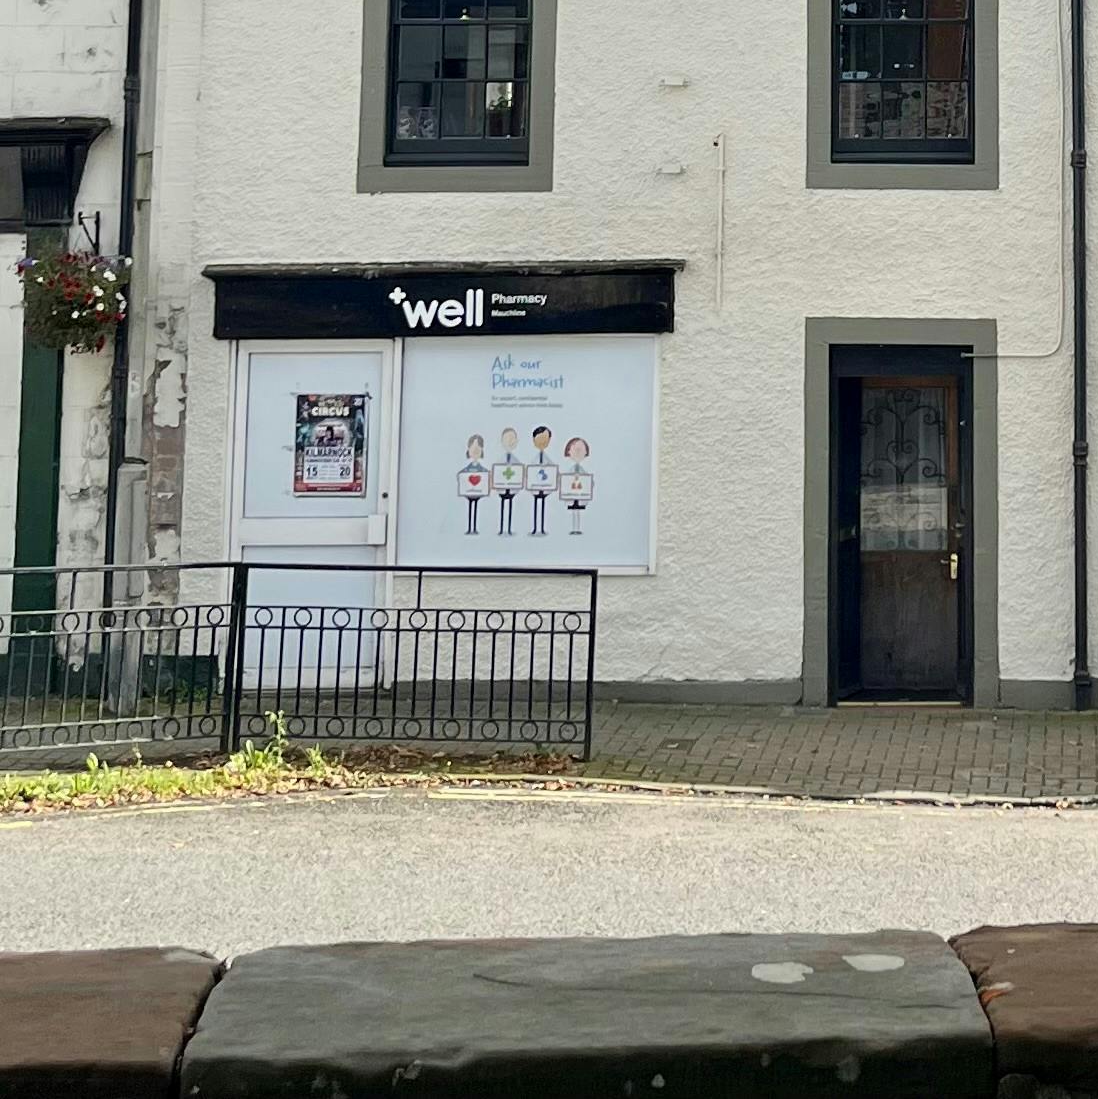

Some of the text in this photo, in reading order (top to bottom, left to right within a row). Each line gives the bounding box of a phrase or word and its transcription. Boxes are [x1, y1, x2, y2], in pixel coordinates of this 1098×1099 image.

[491, 293, 547, 306] Pharmacy
[402, 288, 484, 329] well
[491, 353, 542, 371] Ask our
[492, 373, 564, 390] Pharmacist
[311, 406, 350, 416] CIRCUS
[306, 466, 318, 477] 15
[340, 466, 351, 477] 20
